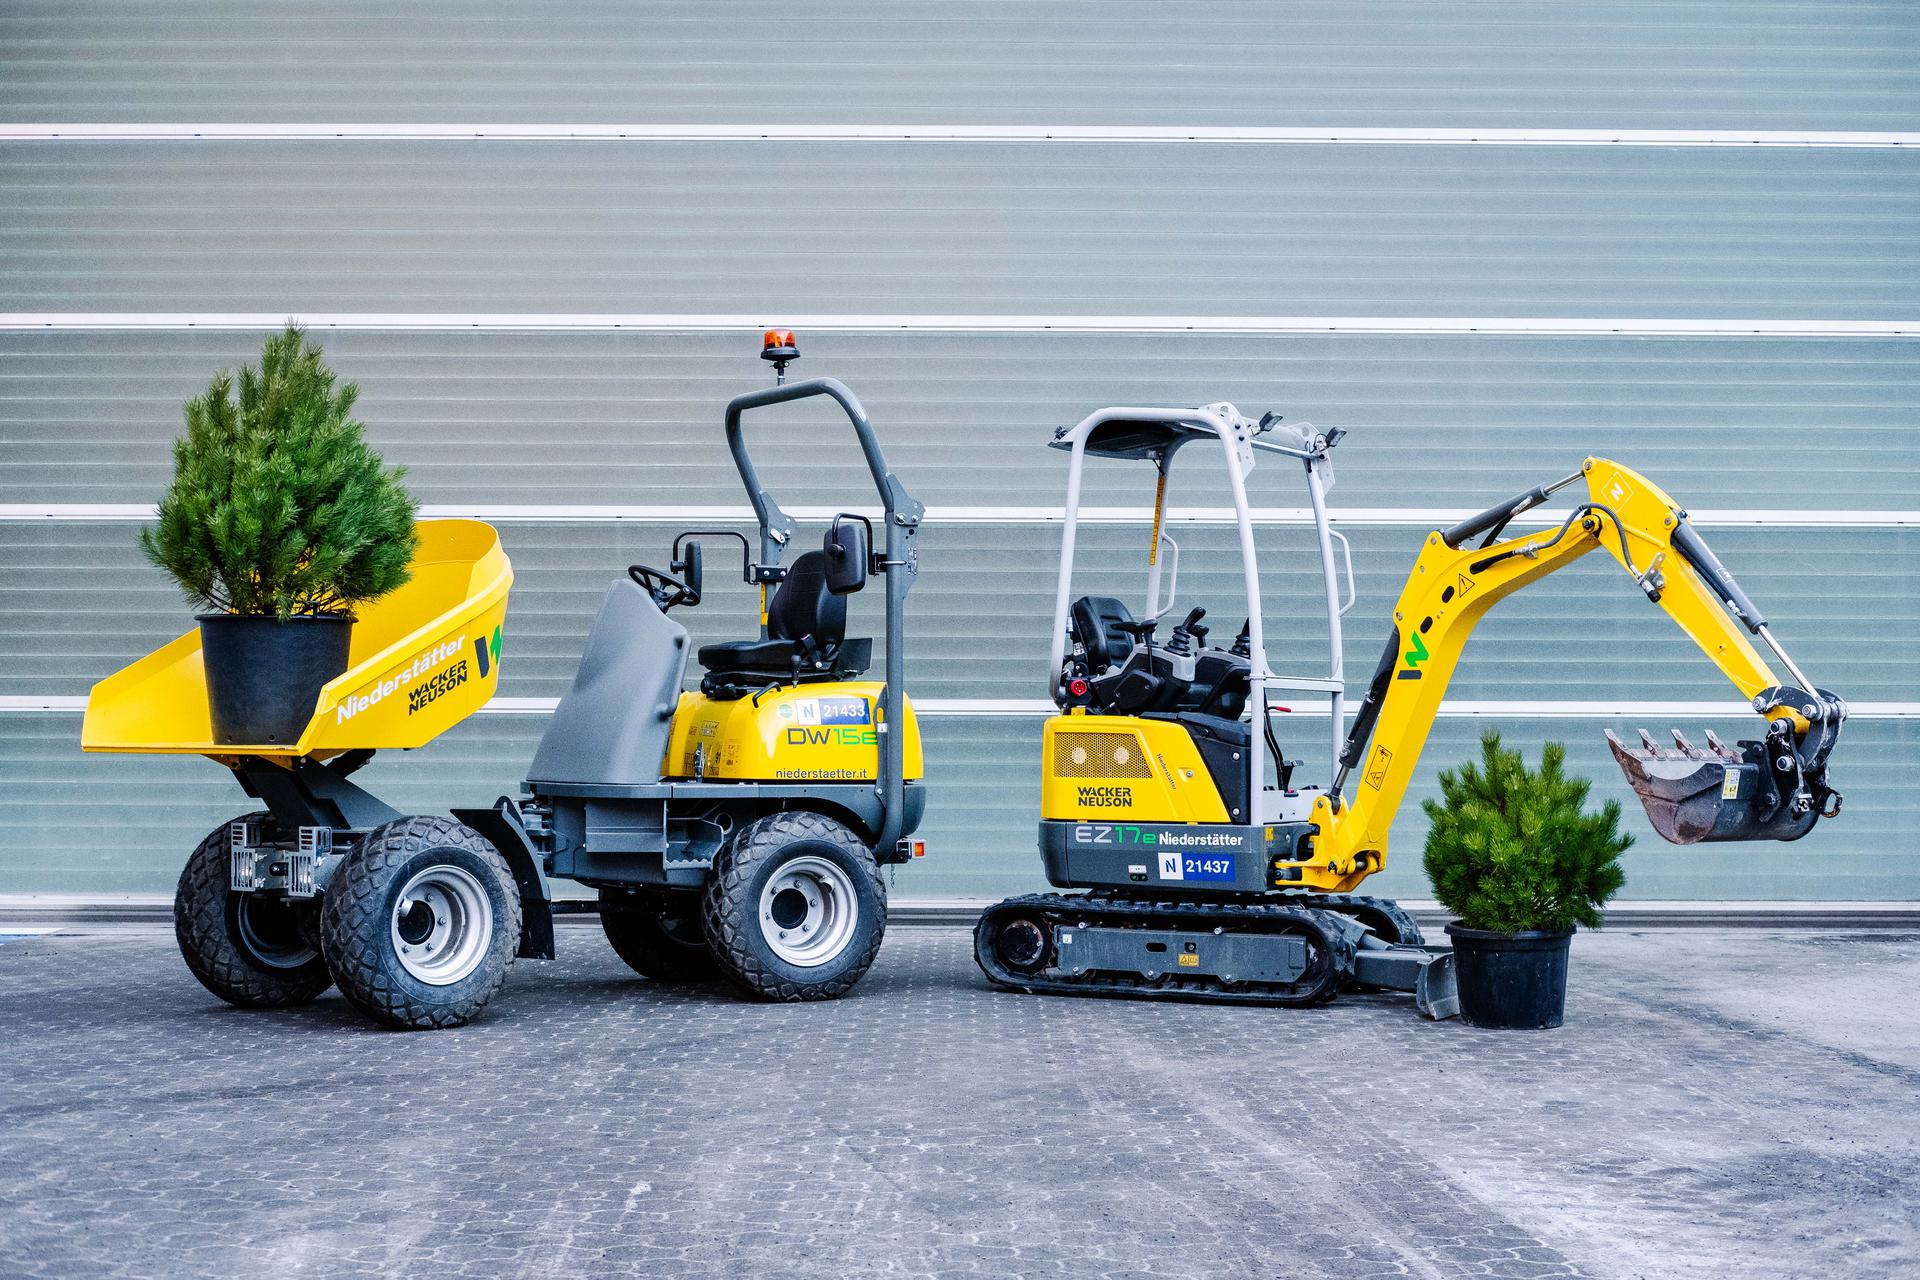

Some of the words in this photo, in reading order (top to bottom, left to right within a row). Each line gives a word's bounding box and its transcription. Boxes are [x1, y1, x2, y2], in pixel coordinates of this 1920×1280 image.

[336, 634, 466, 725] Niederstätter
[408, 659, 468, 702] WACKER
[408, 670, 468, 716] NEUSON
[823, 704, 865, 718] 21433
[776, 768, 867, 779] niederstaetter.it
[1077, 786, 1132, 797] WACKER
[1078, 797, 1133, 807] NEUSON
[1159, 831, 1243, 846] Niederstätter
[1165, 857, 1177, 873] N
[1185, 860, 1230, 874] 21437
